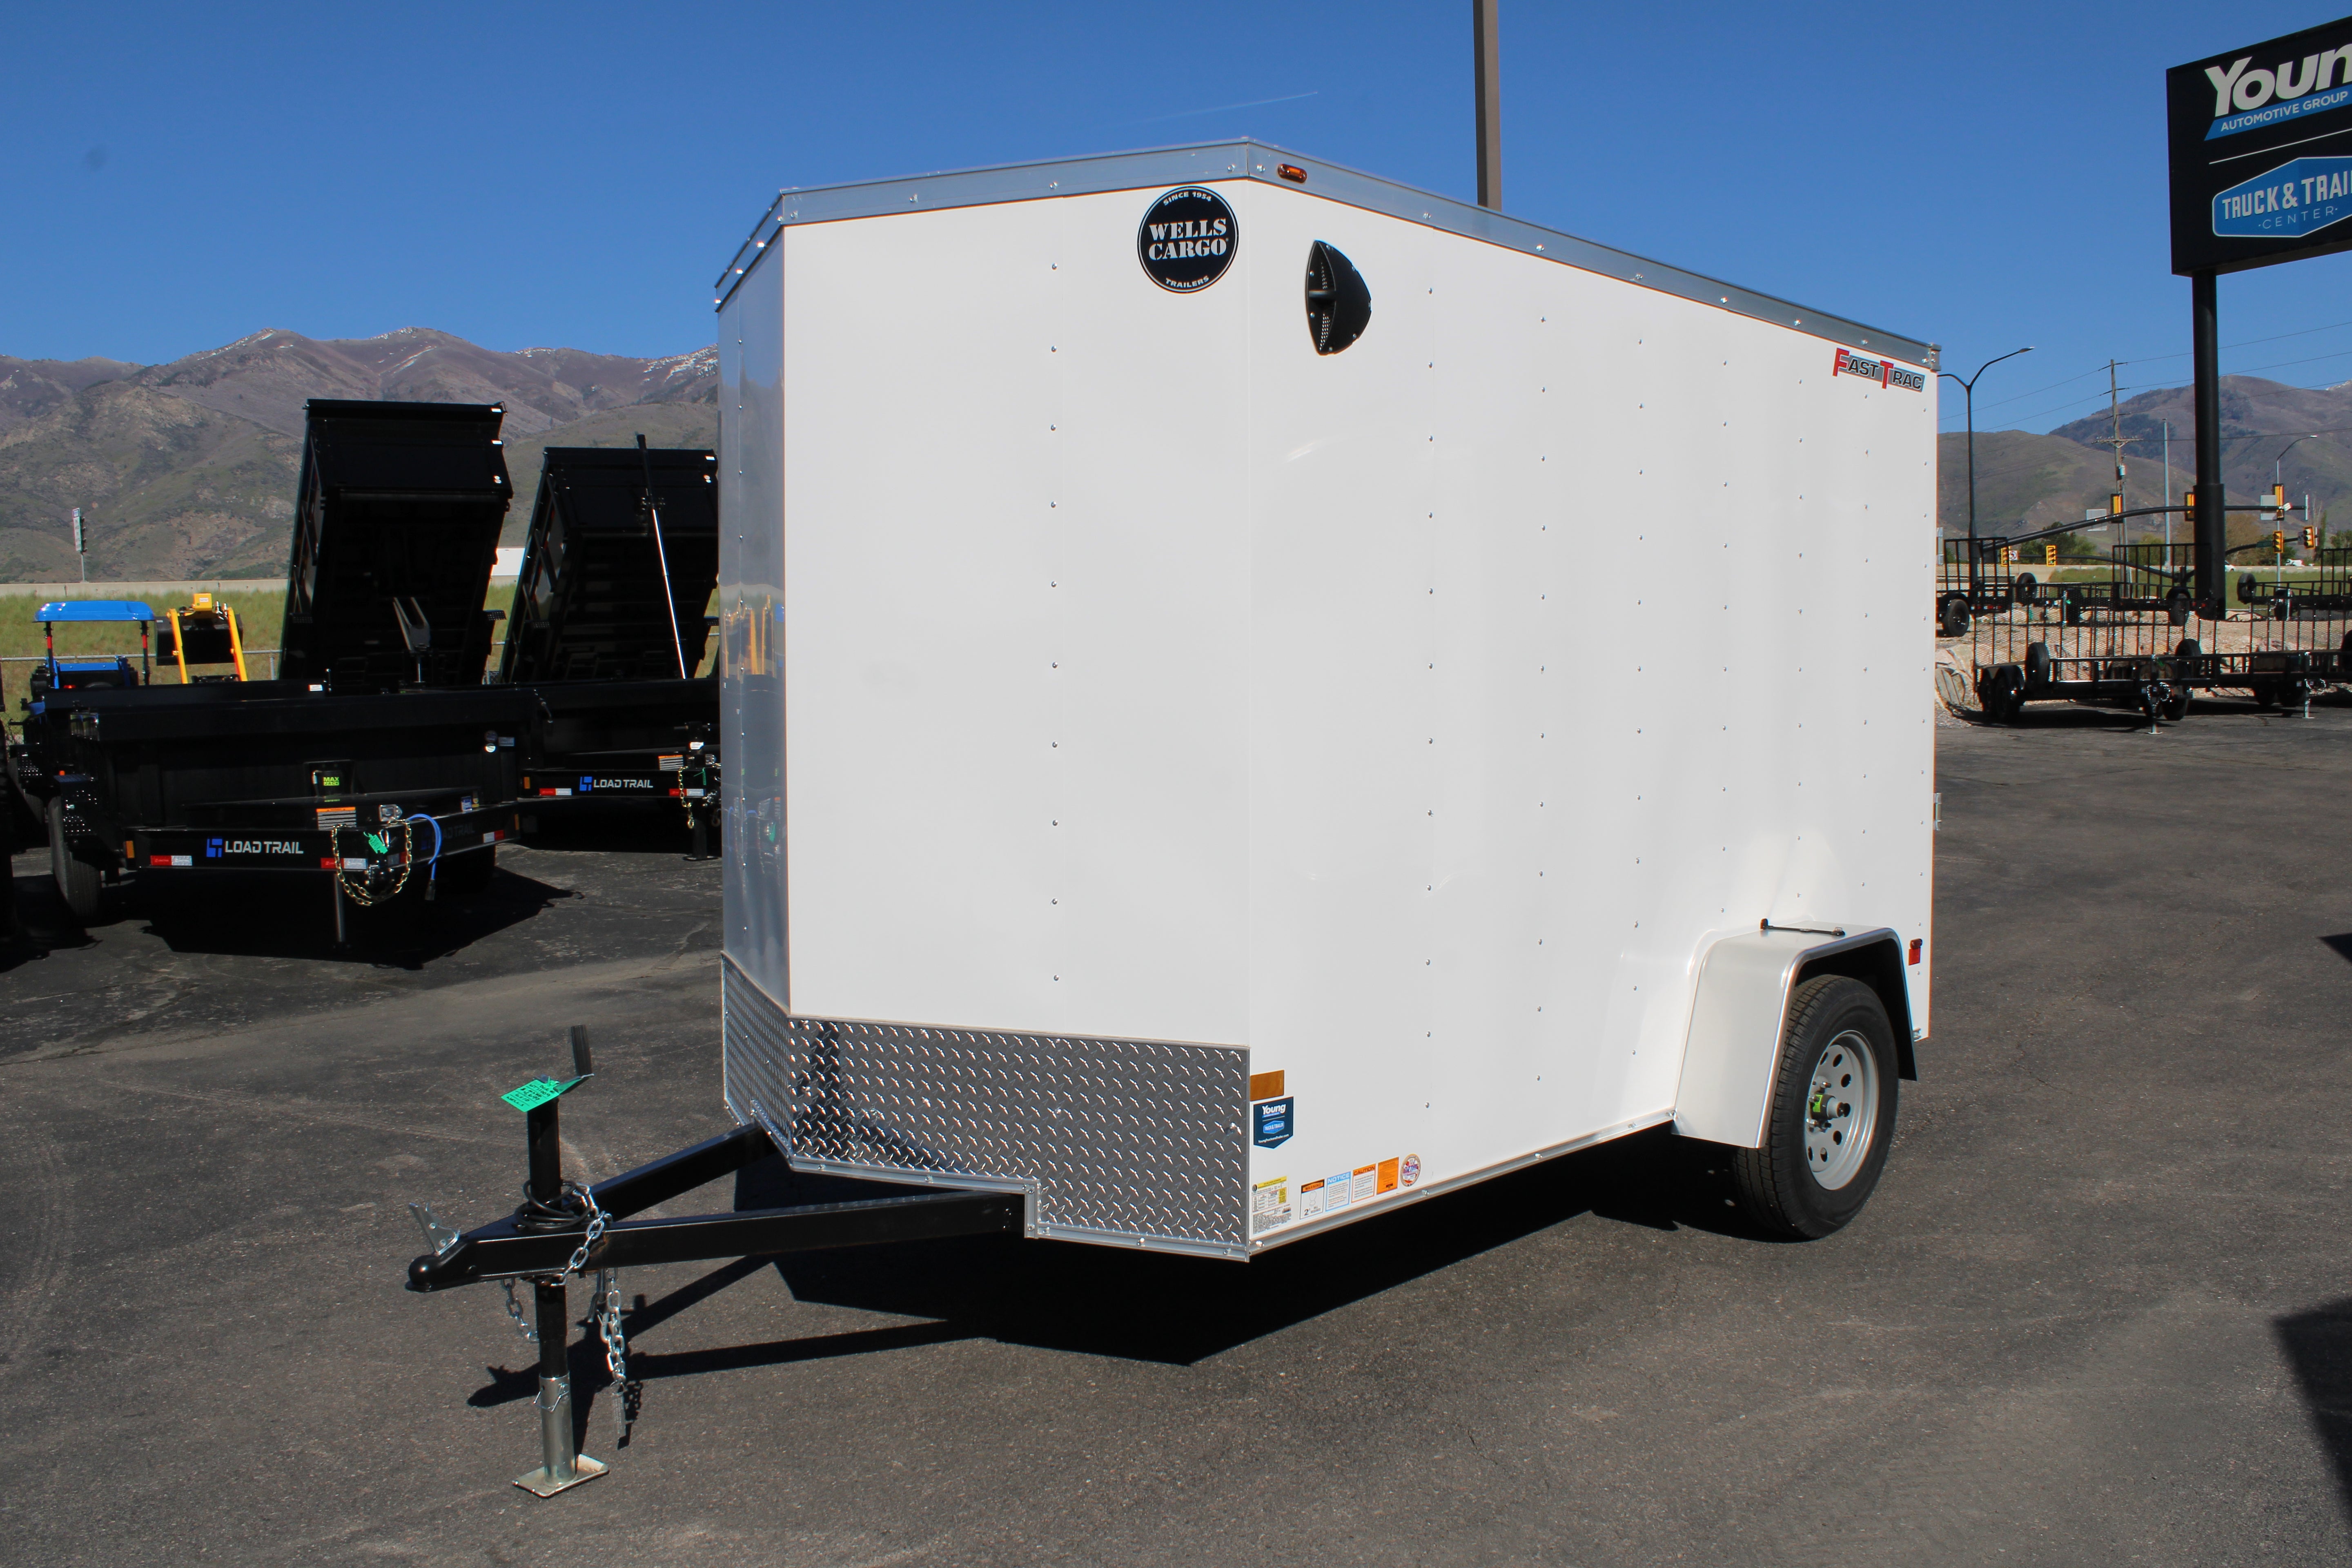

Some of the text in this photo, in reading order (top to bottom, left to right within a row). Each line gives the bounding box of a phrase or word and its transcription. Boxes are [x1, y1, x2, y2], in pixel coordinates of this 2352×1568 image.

[2221, 91, 2348, 131] AUTOMOTIVE GROUP
[1163, 192, 1212, 205] SINCE 1954
[2222, 170, 2352, 220] TRUCK & TRAI
[1149, 218, 1227, 241] WELLS
[1149, 238, 1227, 261] CARGO
[1166, 276, 1209, 288] TRAILERS
[594, 780, 653, 788] LOAD TRAIL
[225, 841, 304, 854] LOAD TRAIL
[1262, 1104, 1286, 1115] Young
[1354, 1165, 1375, 1176] CAUTION
[1327, 1172, 1350, 1184] NOTICE
